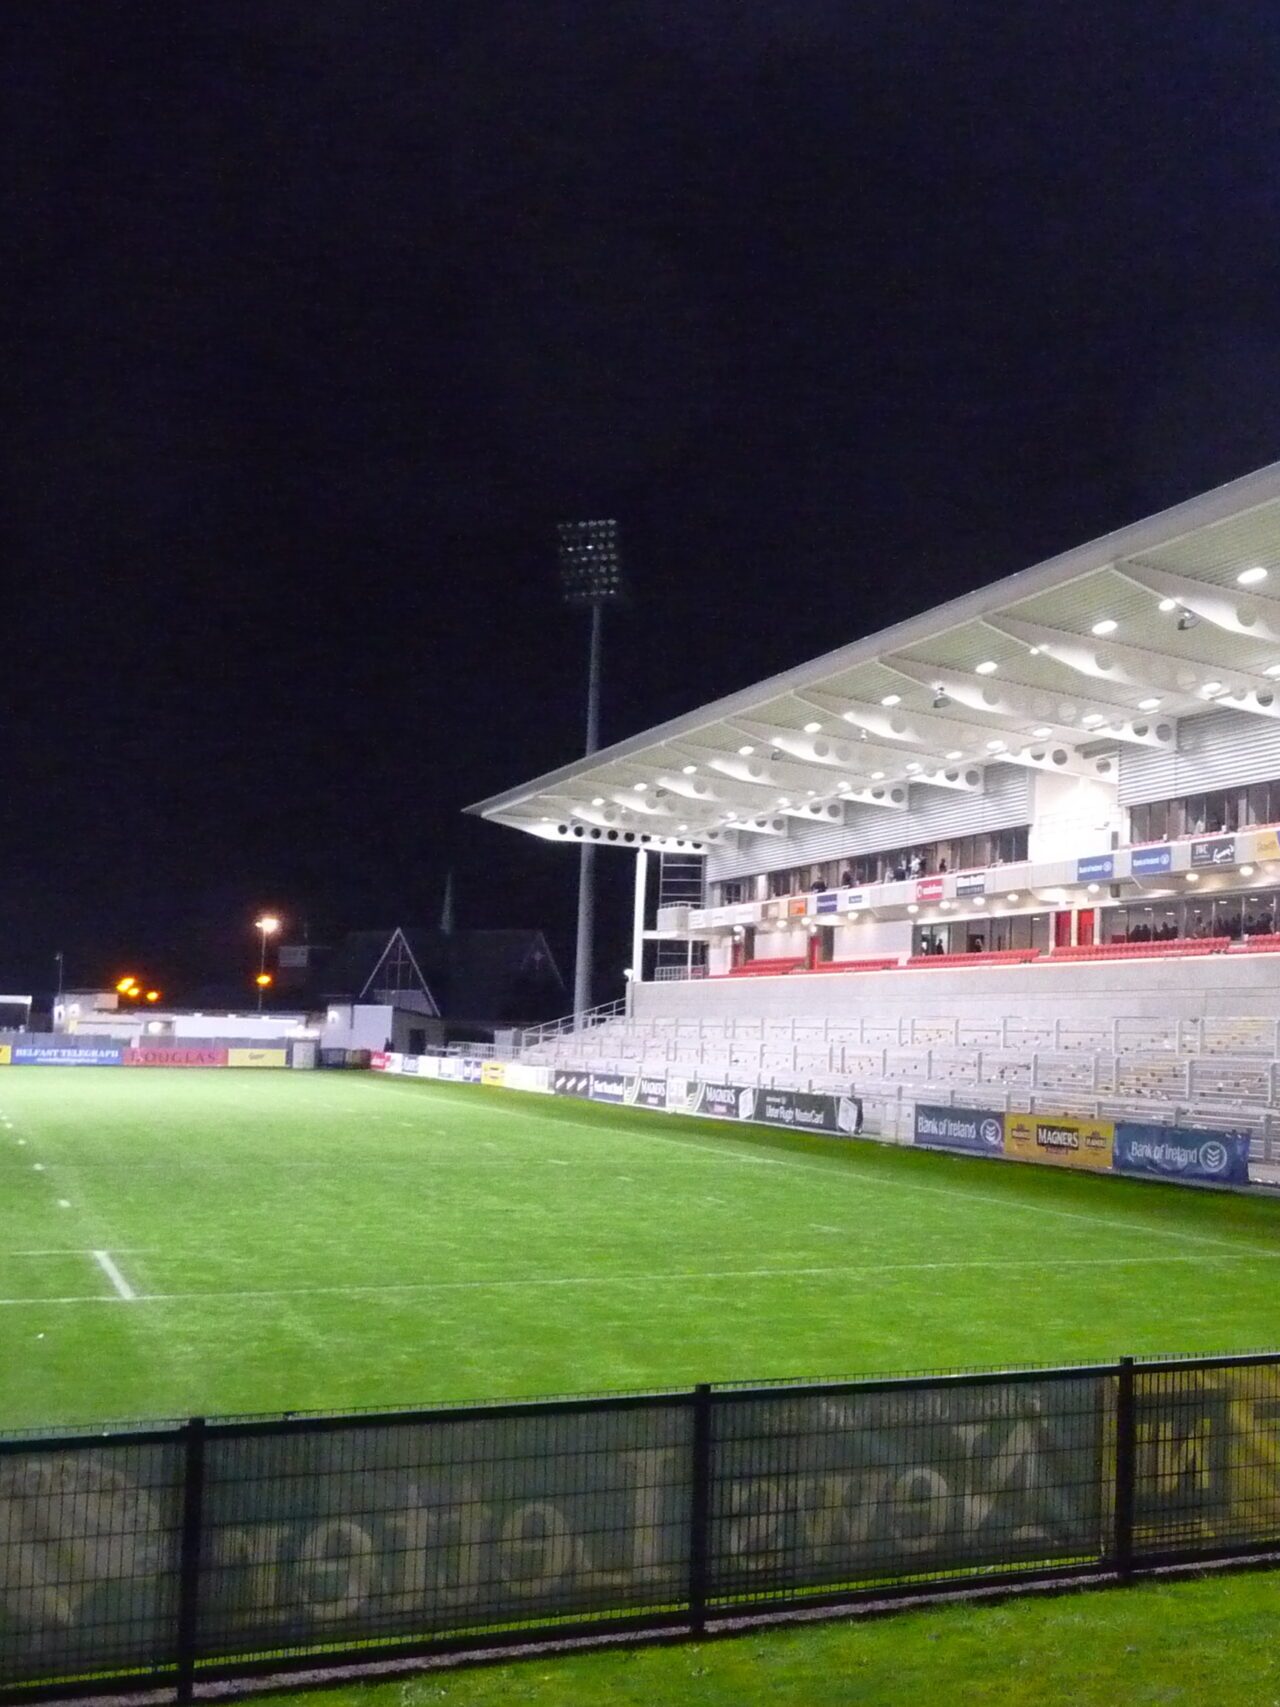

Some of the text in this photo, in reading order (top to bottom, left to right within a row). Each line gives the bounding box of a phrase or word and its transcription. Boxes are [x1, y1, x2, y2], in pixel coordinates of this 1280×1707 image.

[60, 1049, 119, 1058] TELEGRAPH
[918, 1116, 976, 1139] Bank of Ireland
[1038, 1127, 1079, 1147] MAGNERS
[1131, 1141, 1197, 1163] Bank of Ireland
